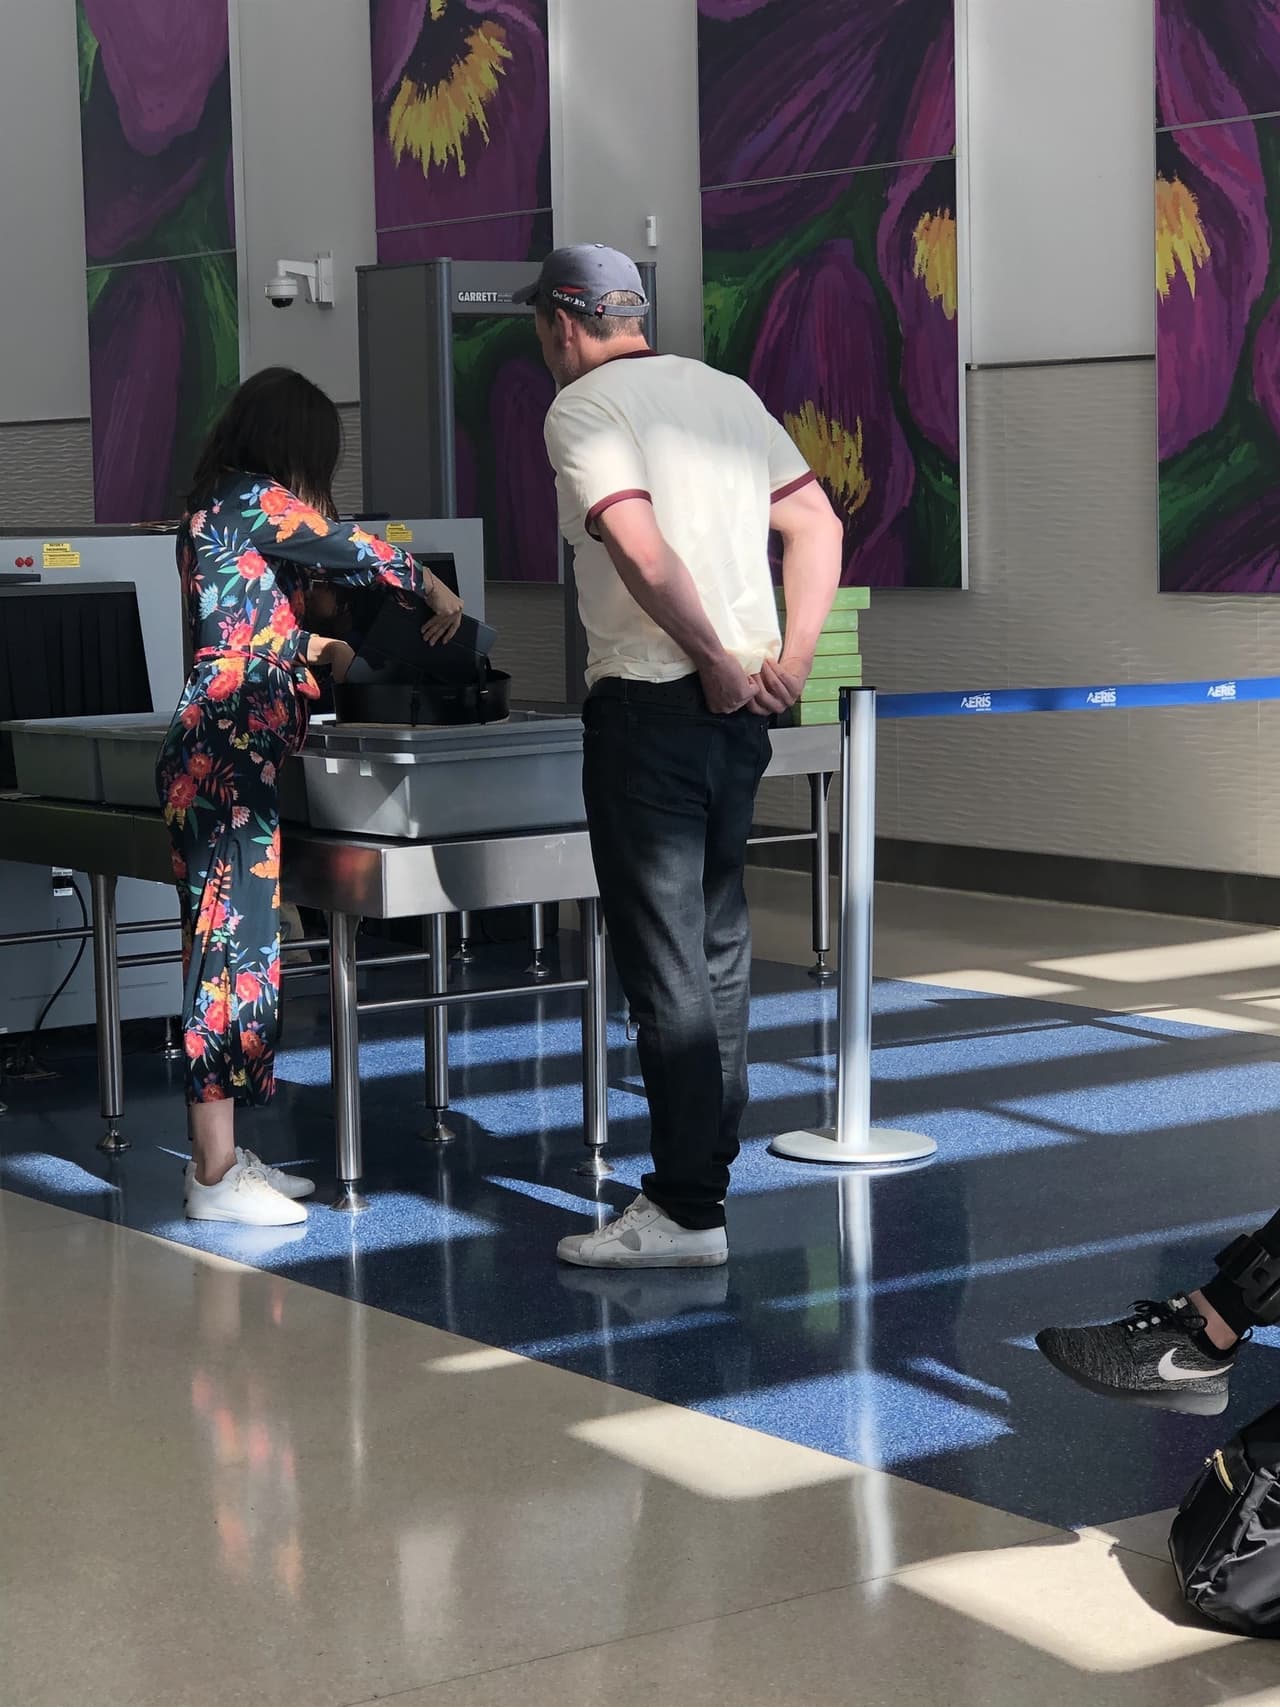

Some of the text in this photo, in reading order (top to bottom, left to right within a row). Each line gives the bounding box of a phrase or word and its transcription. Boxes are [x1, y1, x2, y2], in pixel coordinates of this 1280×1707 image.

[458, 291, 498, 302] GARRETT
[1086, 690, 1117, 704] AERIS
[1206, 684, 1237, 698] AERIS
[960, 695, 992, 708] AERIS
